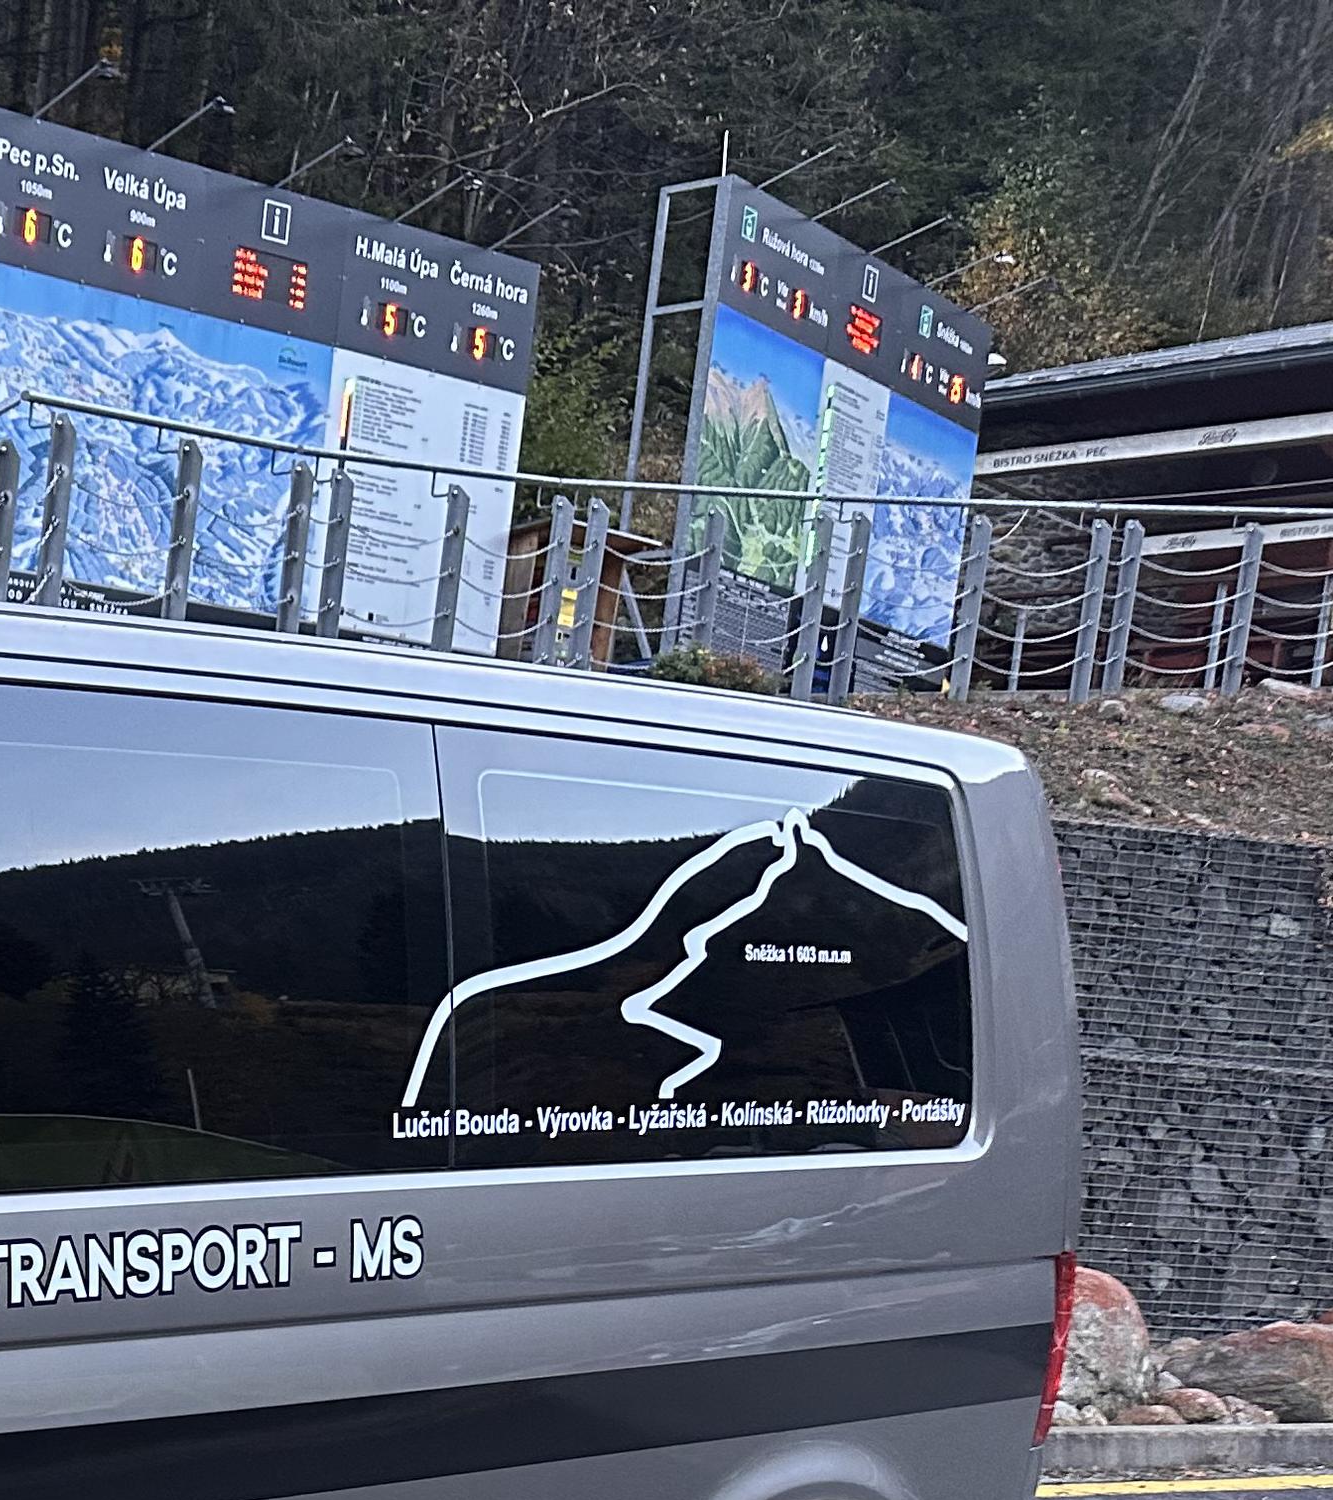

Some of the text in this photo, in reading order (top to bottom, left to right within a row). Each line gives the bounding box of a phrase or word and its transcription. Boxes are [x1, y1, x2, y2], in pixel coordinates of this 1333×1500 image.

[35, 152, 80, 182] p.Sn.
[104, 167, 187, 211] Velká Úpa
[23, 208, 38, 244] 6
[131, 236, 145, 273] 6
[356, 235, 439, 279] H.Malá Úpa
[791, 243, 809, 267] hora
[450, 260, 528, 304] Černá hora
[384, 303, 397, 336] 5
[472, 328, 486, 360] 5
[993, 455, 1032, 469] BISTRO
[1085, 446, 1108, 458] PEC
[744, 943, 786, 963] Sněžka
[796, 945, 816, 963] 603
[392, 1110, 450, 1139] Luční
[455, 1109, 520, 1136] Bouda
[536, 1106, 613, 1138] Výrovka
[628, 1103, 706, 1132] Lyžařská
[721, 1100, 793, 1128] Kolínská
[805, 1099, 888, 1131] Růžohorky
[901, 1098, 965, 1128] Portášky
[351, 1218, 423, 1279] MS
